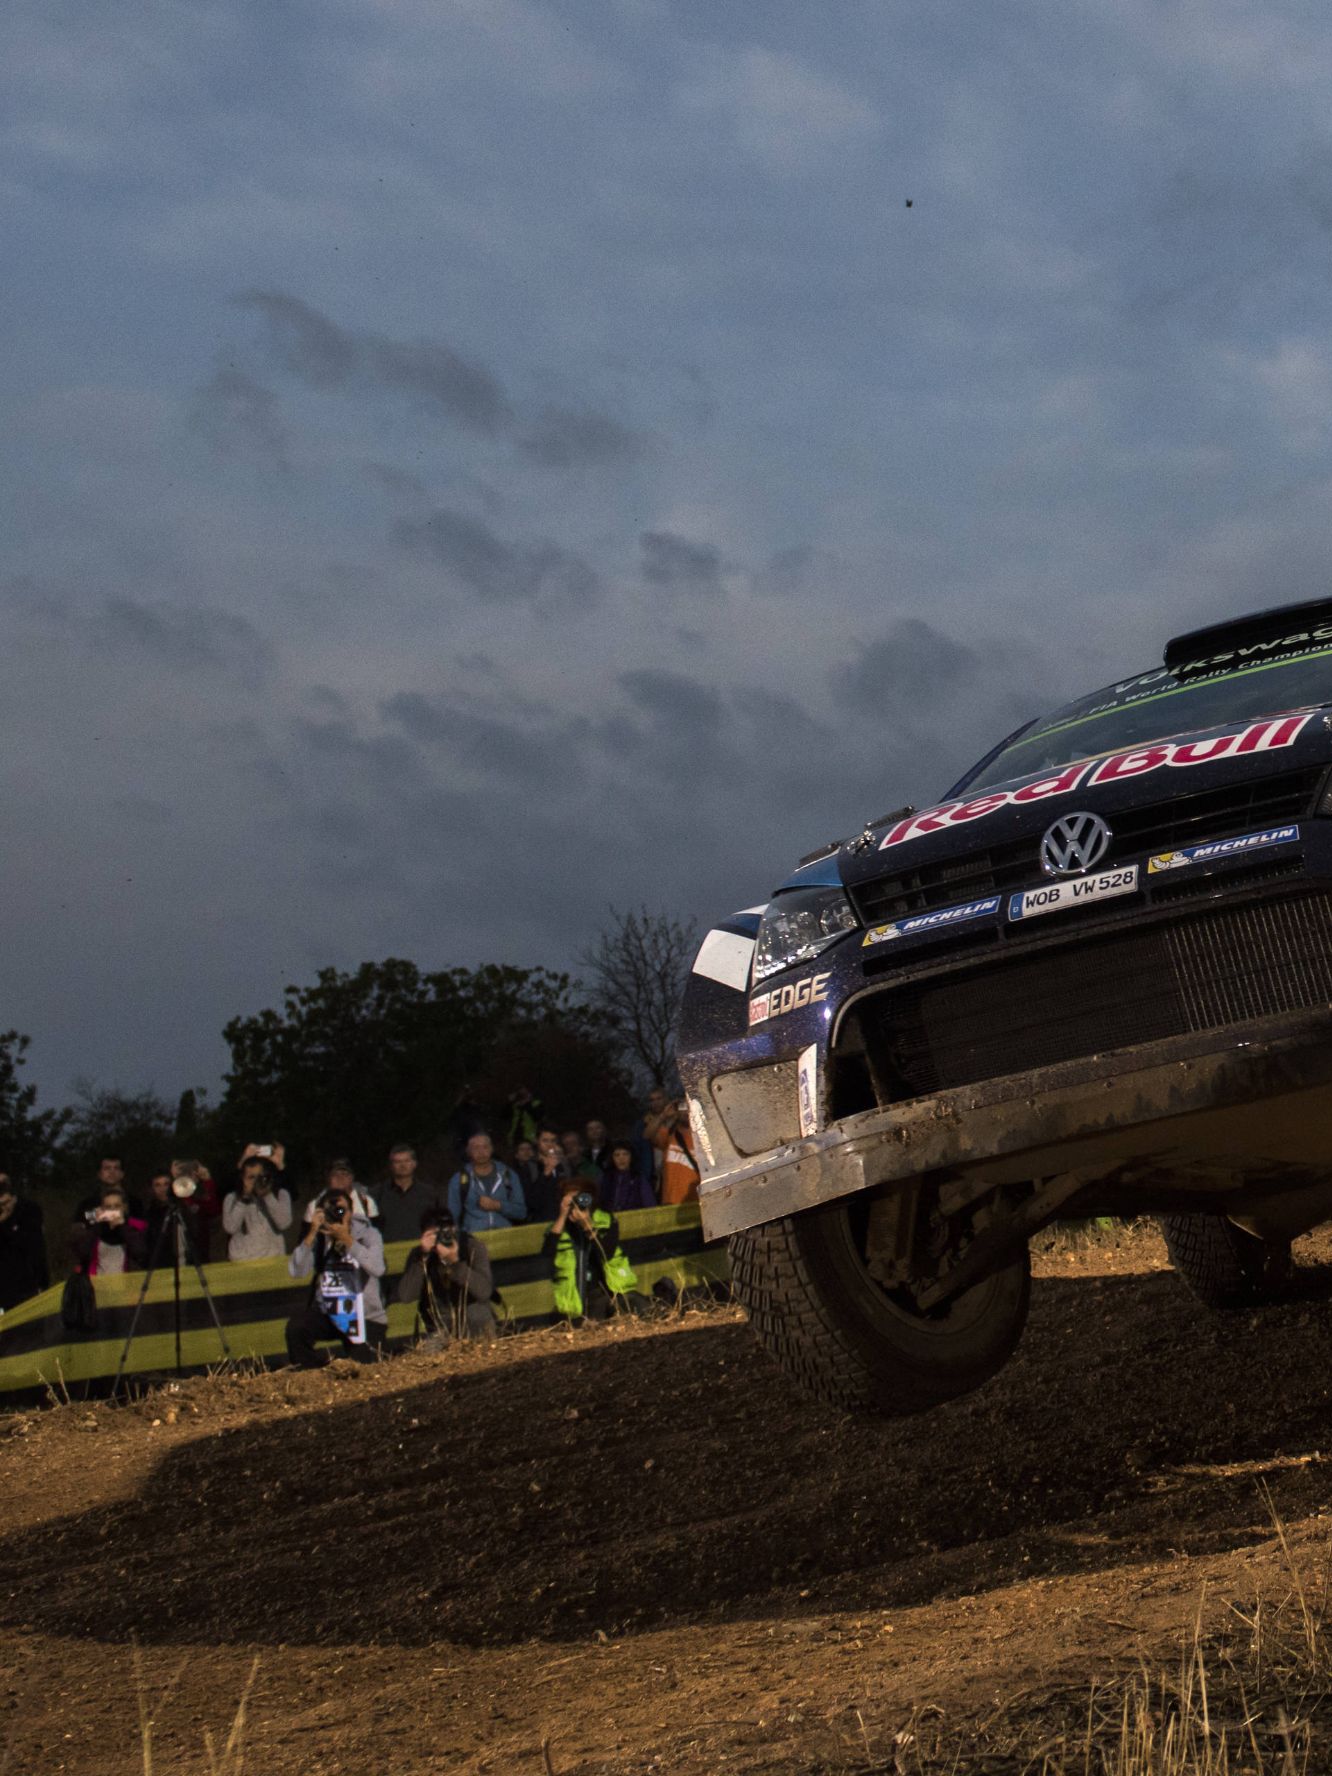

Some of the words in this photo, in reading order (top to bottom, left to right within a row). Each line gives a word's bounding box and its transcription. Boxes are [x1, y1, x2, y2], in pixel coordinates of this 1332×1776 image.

[1125, 681, 1178, 702] World
[1184, 667, 1231, 685] Rally
[879, 762, 1091, 850] Red
[1087, 714, 1314, 786] Bull
[1193, 828, 1294, 857] MICHELIN
[1025, 888, 1060, 909] WOB
[1073, 879, 1096, 897] VW
[1098, 871, 1134, 891] 528
[904, 900, 996, 929] MICHELIN
[769, 971, 833, 1018] EDGE
